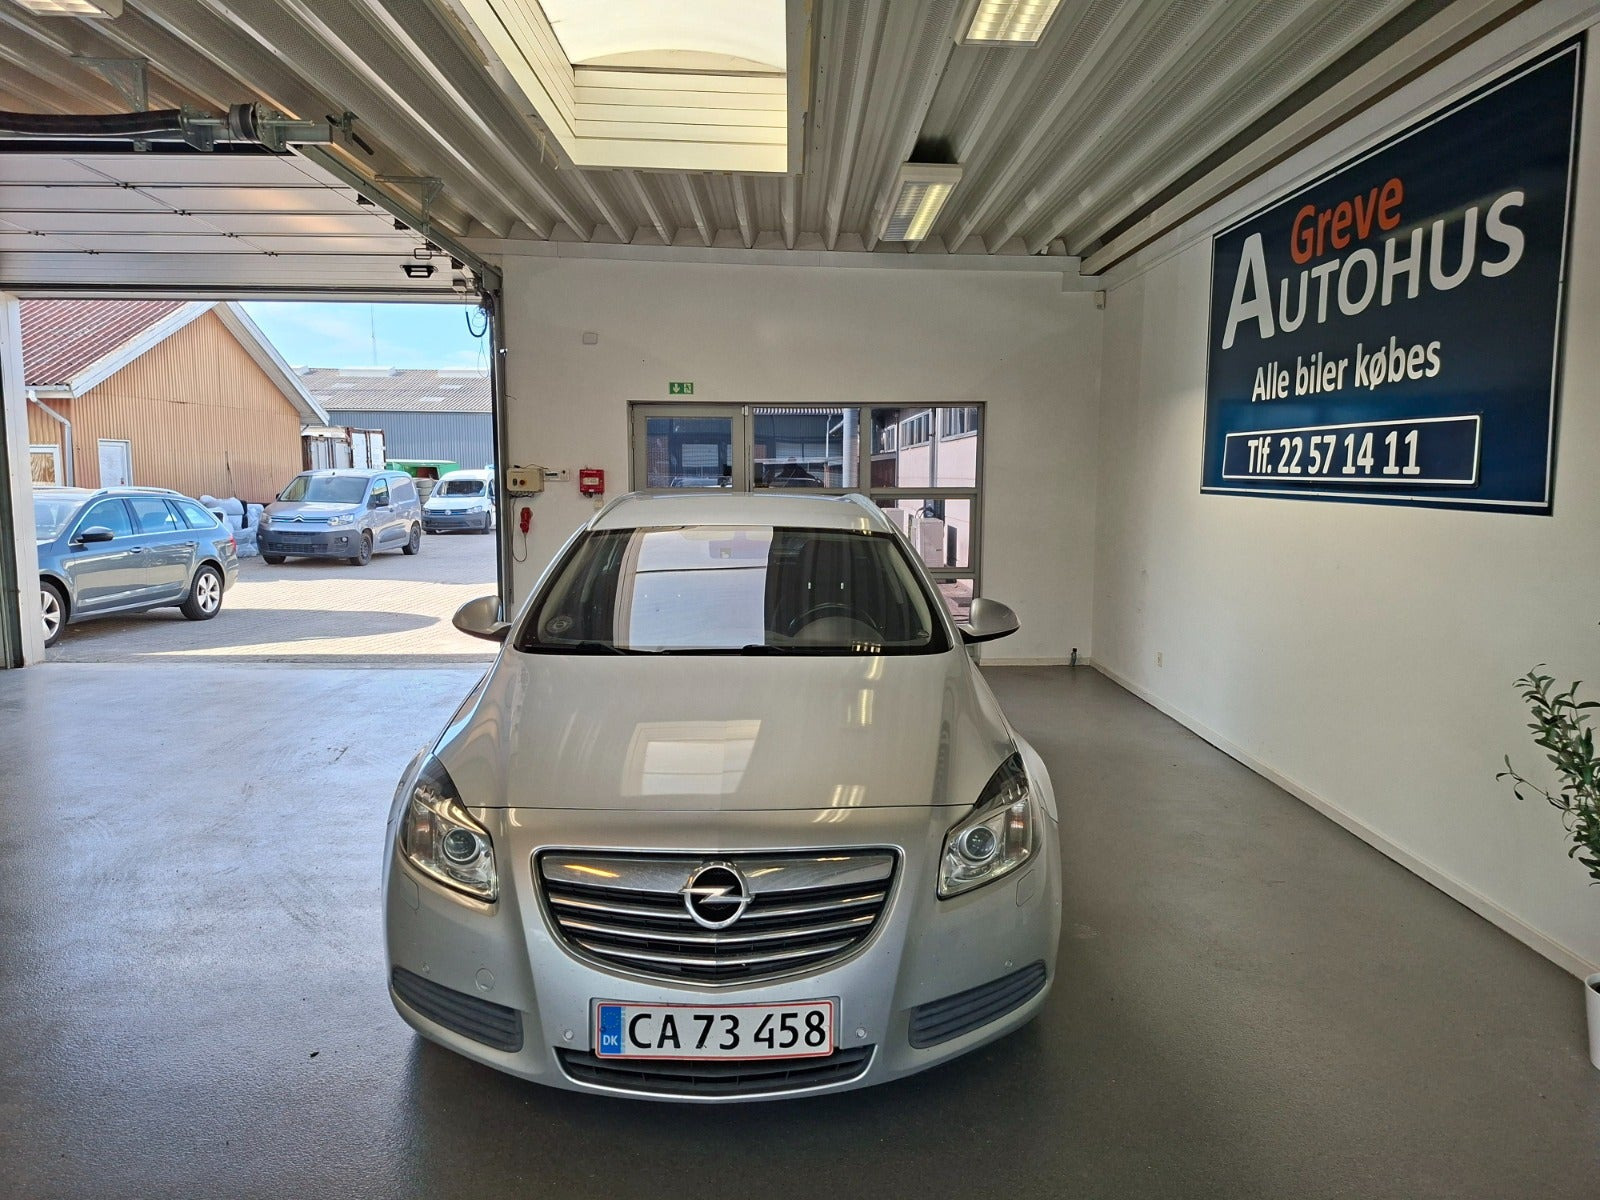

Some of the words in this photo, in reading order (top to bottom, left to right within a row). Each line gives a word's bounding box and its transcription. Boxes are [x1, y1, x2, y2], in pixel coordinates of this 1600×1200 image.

[1290, 178, 1405, 264] Greve
[1221, 191, 1525, 350] AUTOHUS
[1251, 362, 1290, 403] Alle
[1294, 351, 1349, 396] biler
[1355, 335, 1441, 391] købes
[1247, 436, 1272, 474] Tlf.
[1277, 436, 1303, 474] 22
[1308, 434, 1337, 475] 57
[1342, 432, 1374, 475] 14
[1383, 429, 1421, 475] 11
[603, 1034, 618, 1046] DK
[628, 1013, 681, 1049] CA
[693, 1014, 740, 1050] 73
[753, 1010, 826, 1049] 458
